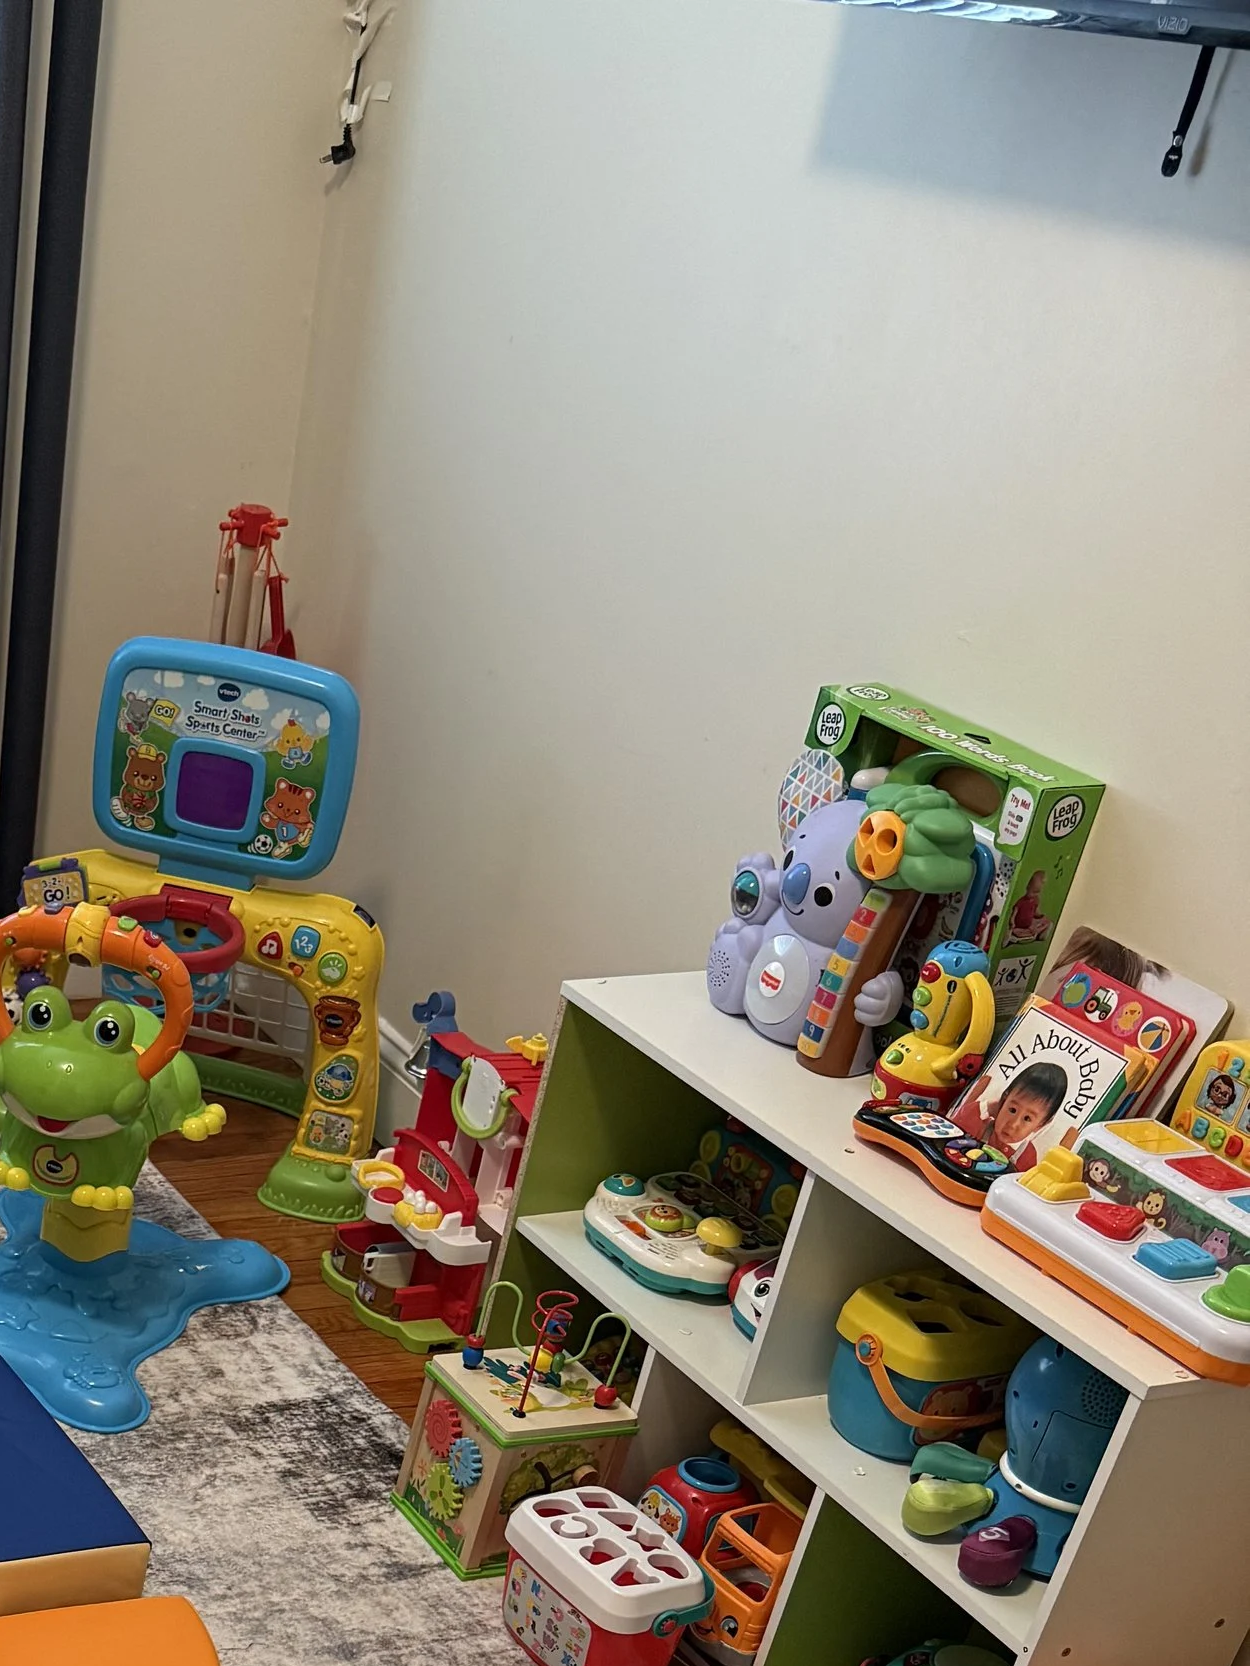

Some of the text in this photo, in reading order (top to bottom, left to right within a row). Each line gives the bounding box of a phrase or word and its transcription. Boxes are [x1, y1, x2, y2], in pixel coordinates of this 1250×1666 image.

[1158, 16, 1188, 31] VIZIO
[155, 704, 175, 718] GO!
[194, 700, 228, 718] Smart
[822, 711, 843, 726] Leap
[820, 724, 840, 740] Frog
[919, 726, 1056, 782] 100 Words Book
[1053, 801, 1080, 820] Leap
[1052, 813, 1078, 833] Frog
[44, 886, 70, 902] GO!
[294, 936, 314, 954] 123
[999, 1029, 1100, 1120] All About Baby
